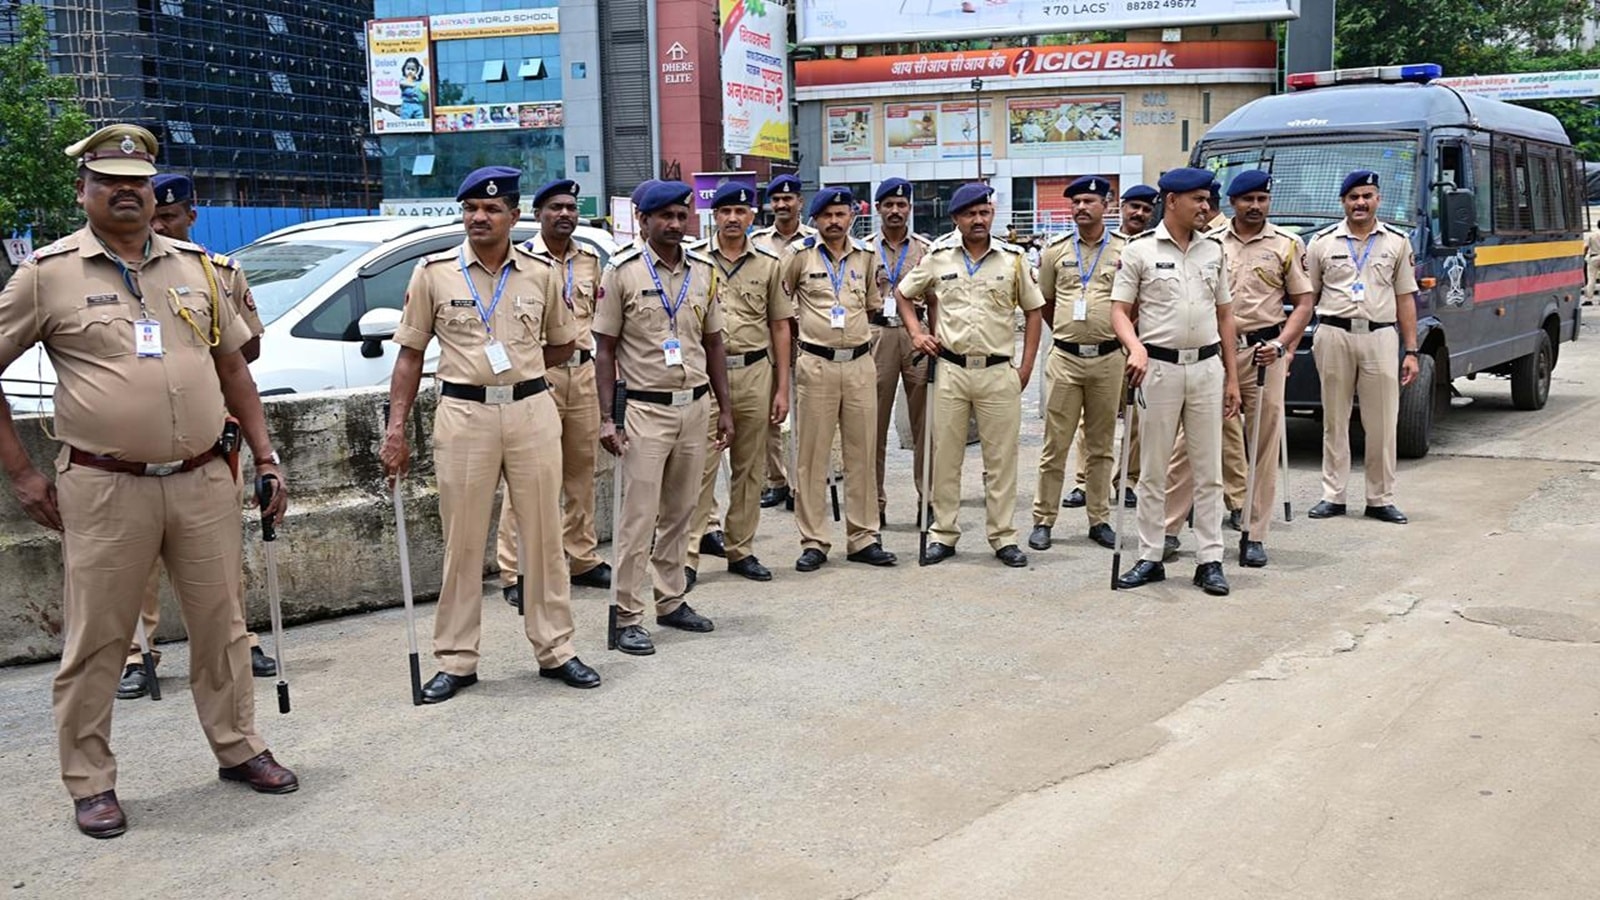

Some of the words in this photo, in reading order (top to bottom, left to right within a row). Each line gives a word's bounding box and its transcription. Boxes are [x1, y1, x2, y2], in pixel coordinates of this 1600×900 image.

[1054, 5, 1069, 15] 70
[1126, 0, 1160, 11] 88282
[1162, 0, 1197, 8] 49672
[432, 18, 475, 26] AARYANS
[478, 15, 511, 24] WORLD
[513, 13, 554, 21] SCHOOL
[375, 58, 397, 67] Unlock
[1034, 51, 1101, 71] ICICI
[1104, 49, 1175, 69] Bank
[662, 61, 694, 72] DHERE
[891, 61, 912, 74] आय
[665, 73, 692, 84] ELITE
